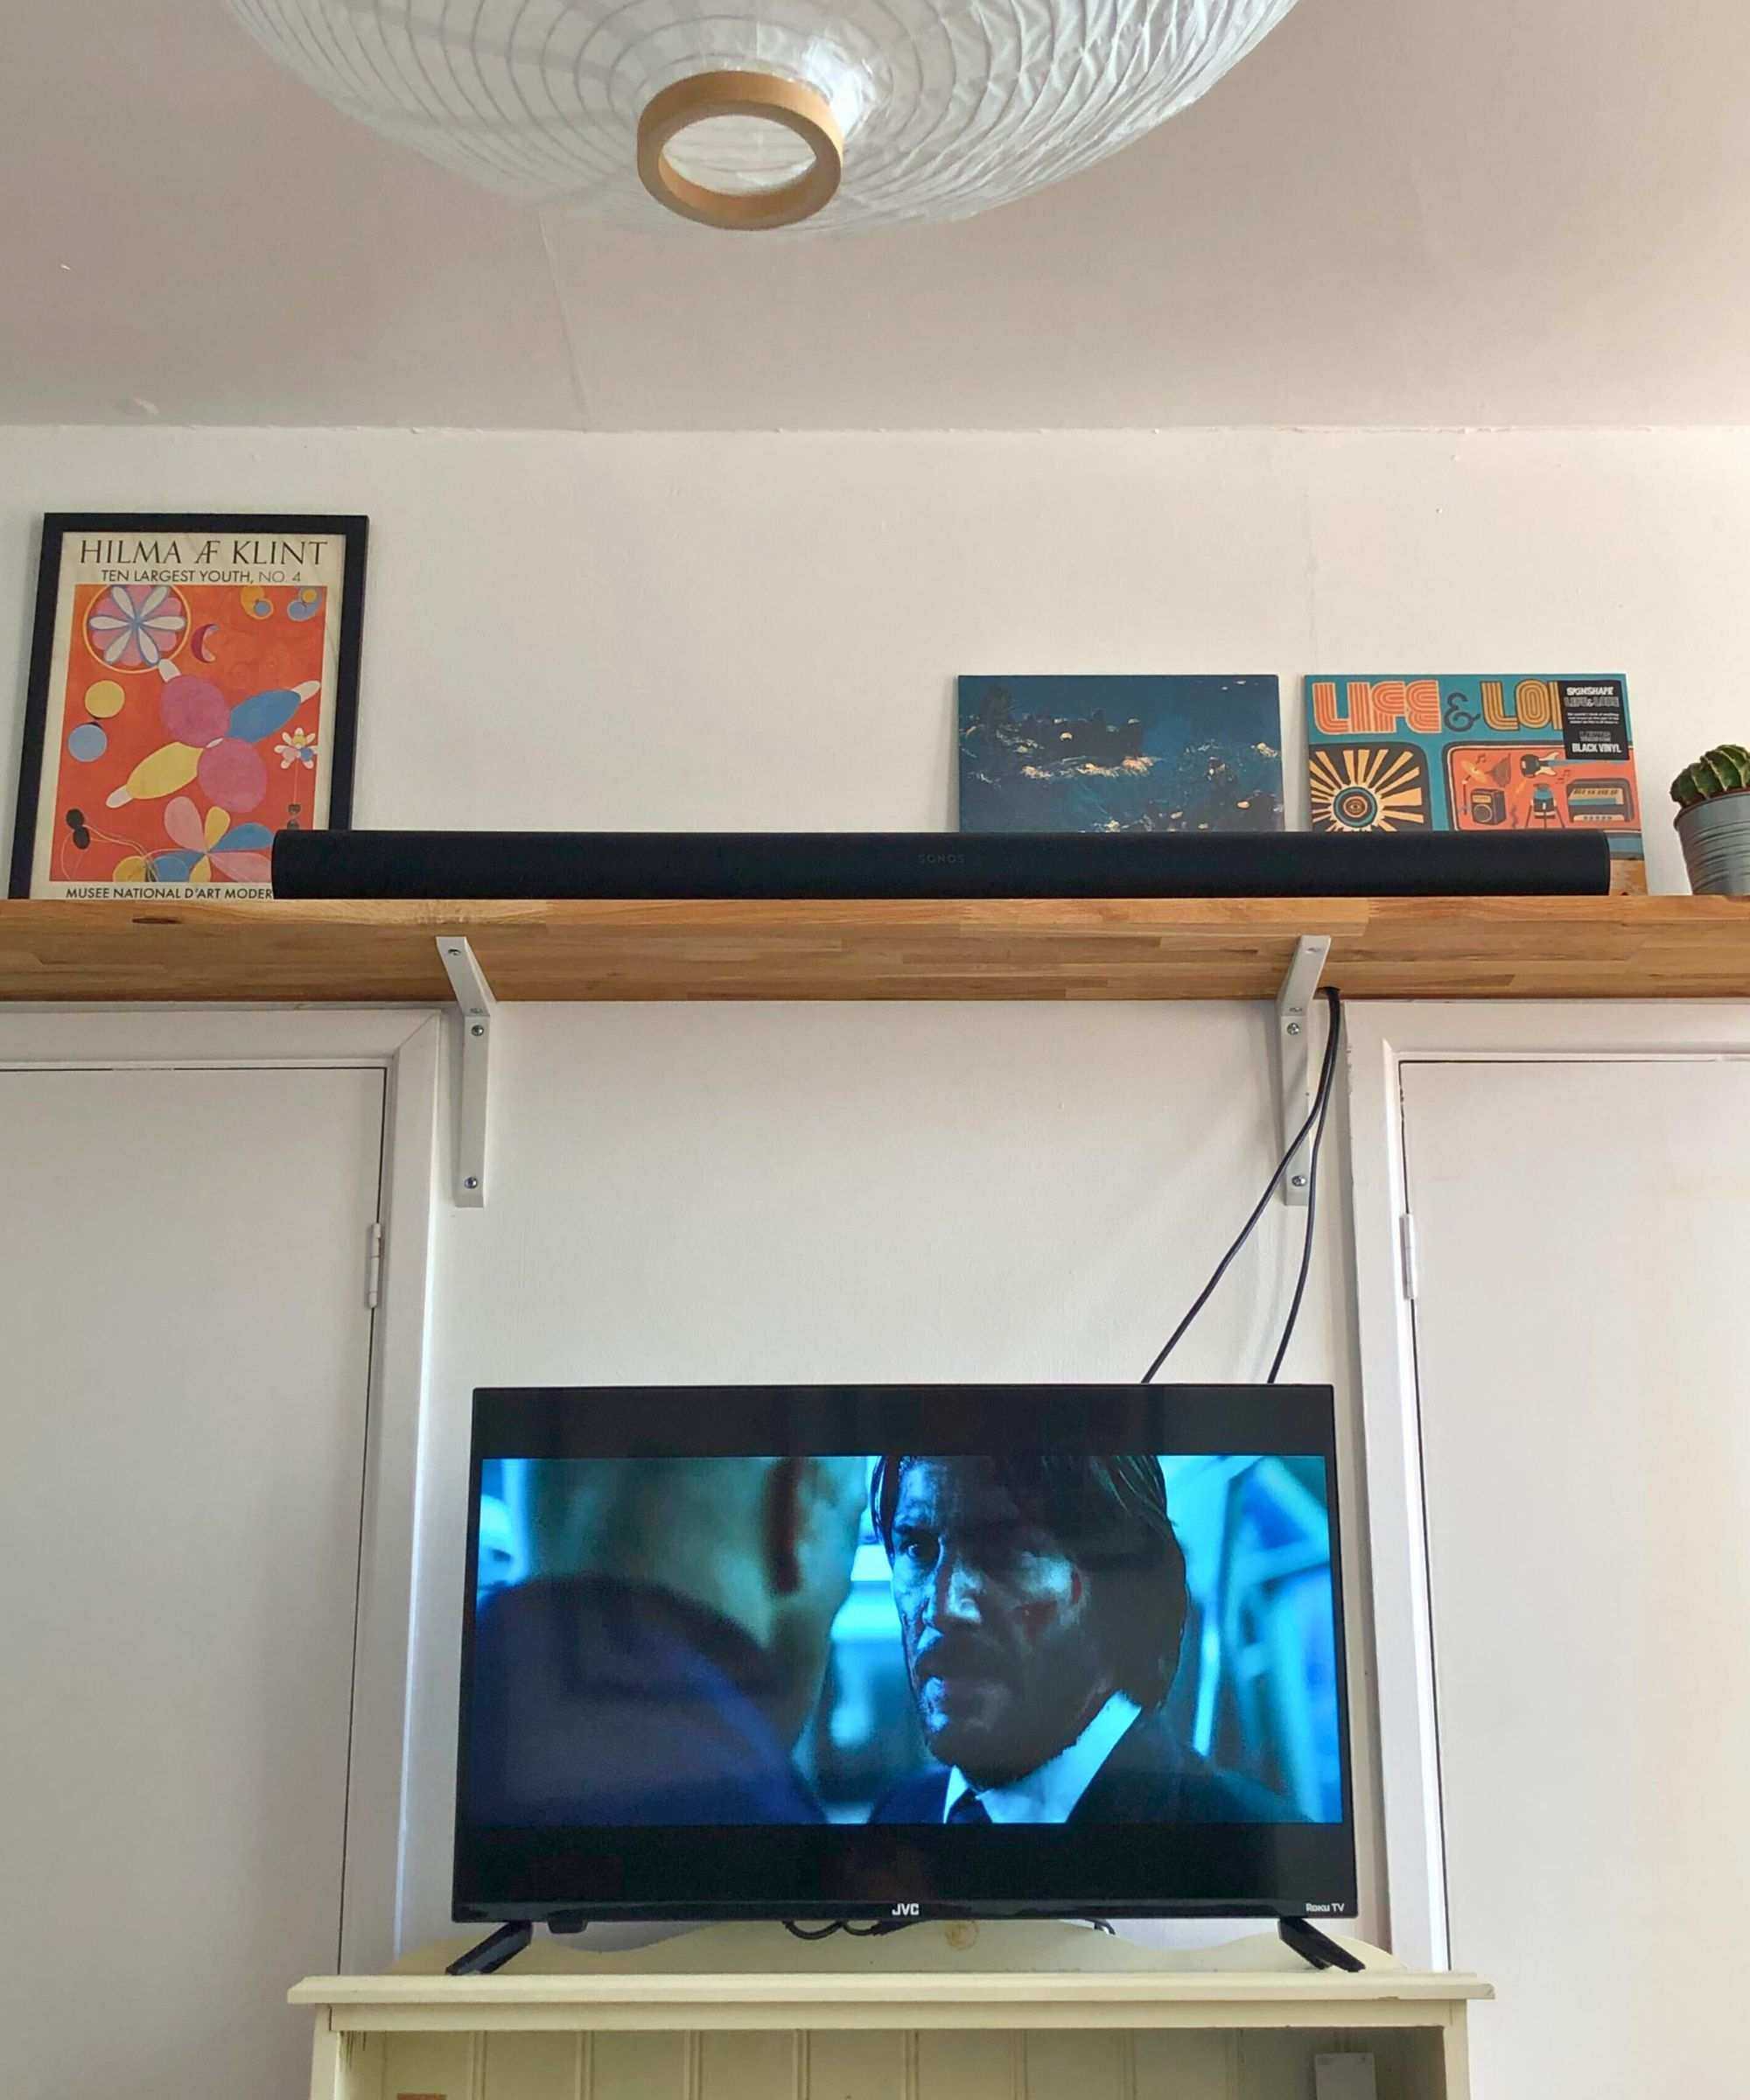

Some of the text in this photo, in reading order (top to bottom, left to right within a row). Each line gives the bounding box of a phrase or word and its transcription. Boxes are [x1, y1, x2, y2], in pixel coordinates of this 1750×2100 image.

[80, 539, 182, 564] HILMA
[232, 540, 328, 565] KLINT
[102, 570, 130, 582] TEN
[134, 570, 195, 582] LARGEST
[200, 570, 254, 584] YOUTH,
[292, 571, 301, 582] 4
[1312, 679, 1443, 736] LIFE
[1444, 691, 1481, 733] &
[1572, 743, 1622, 753] BLACK VINYL
[917, 853, 966, 864] SONOS
[66, 887, 109, 900] MUSEE
[114, 887, 181, 900] NATIONAL
[185, 887, 221, 900] D'ART
[892, 1902, 920, 1915] JVC
[1331, 1902, 1345, 1912] TV
